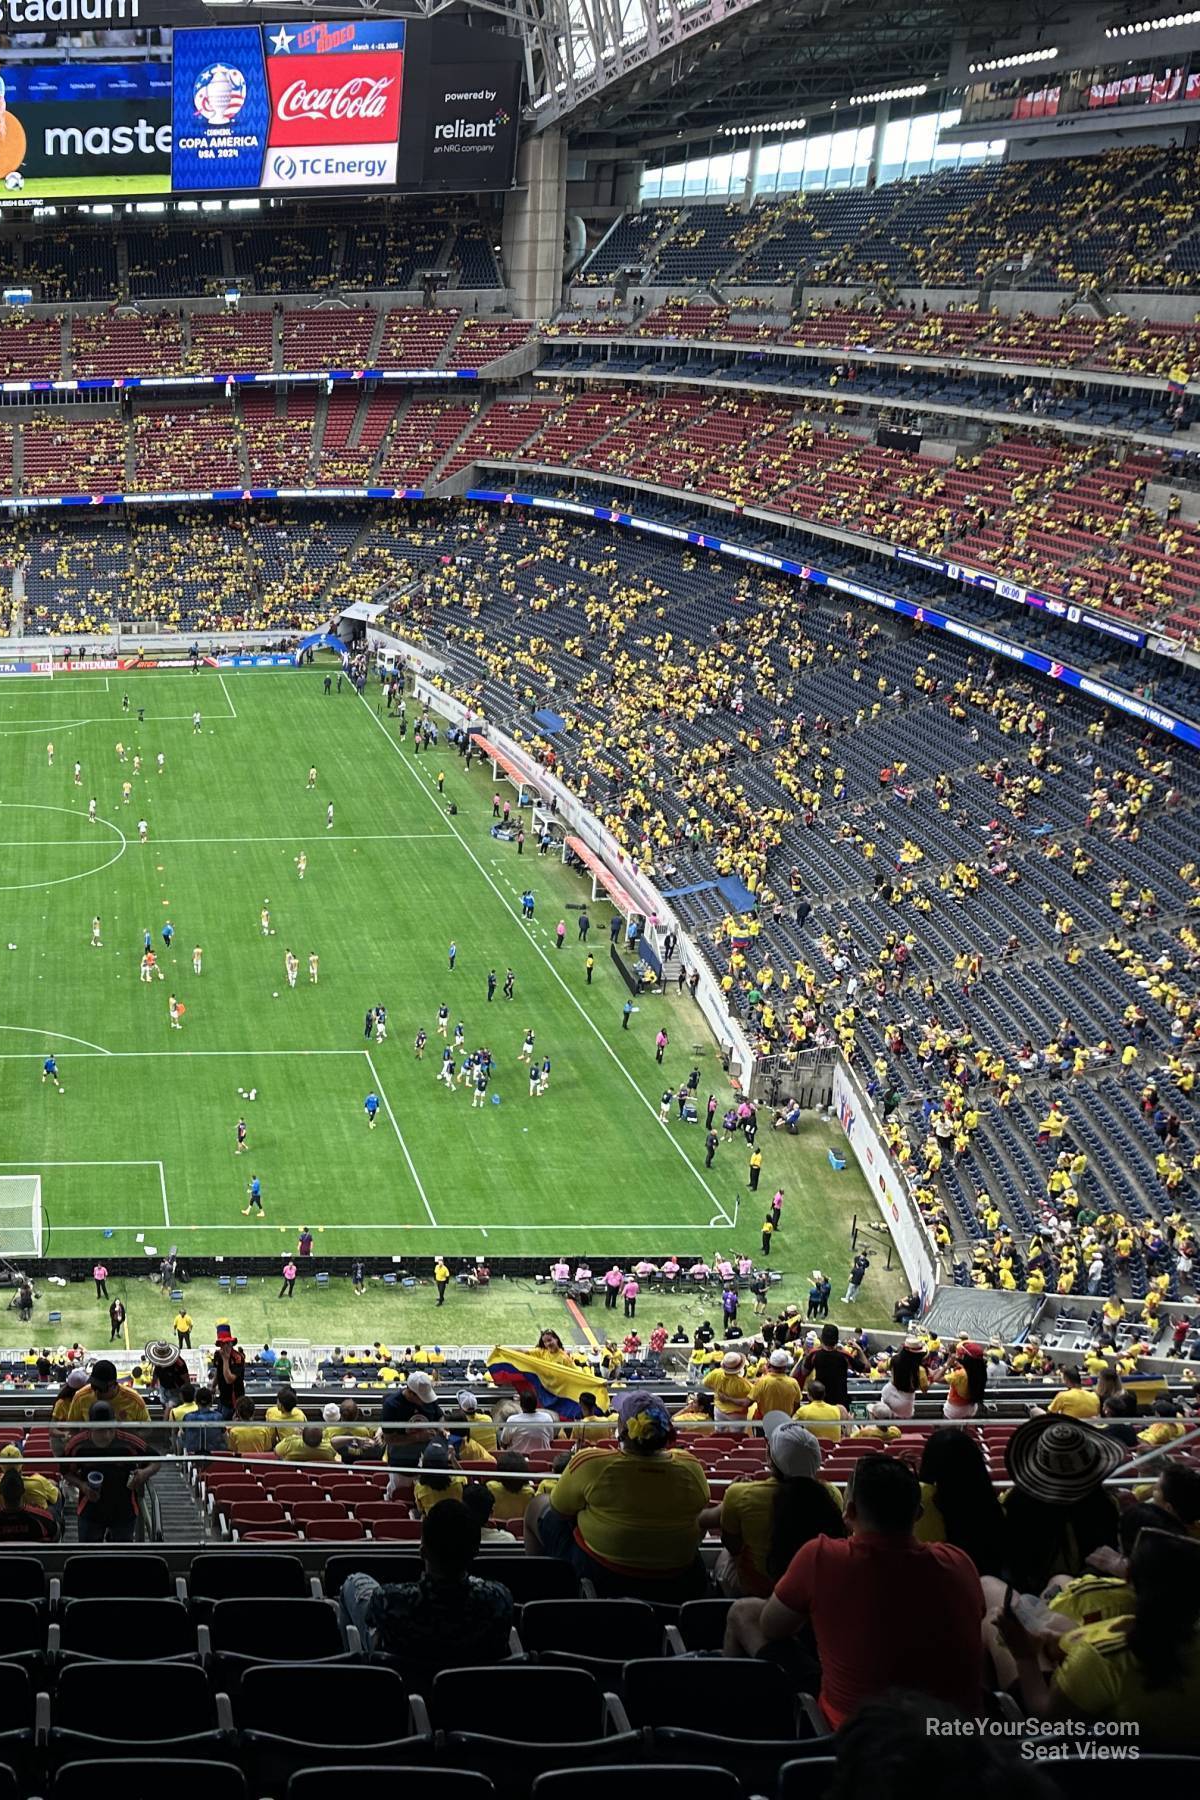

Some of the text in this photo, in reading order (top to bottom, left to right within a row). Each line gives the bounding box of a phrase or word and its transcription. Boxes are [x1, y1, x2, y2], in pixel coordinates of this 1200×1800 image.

[277, 76, 397, 121] Coca-Cola
[445, 90, 497, 102] powered by
[434, 119, 496, 139] reliant
[179, 136, 259, 148] COPA AMERICA
[198, 149, 239, 159] USA 2024
[444, 144, 460, 154] NRG
[462, 144, 495, 154] company
[300, 159, 388, 177] TC Energy
